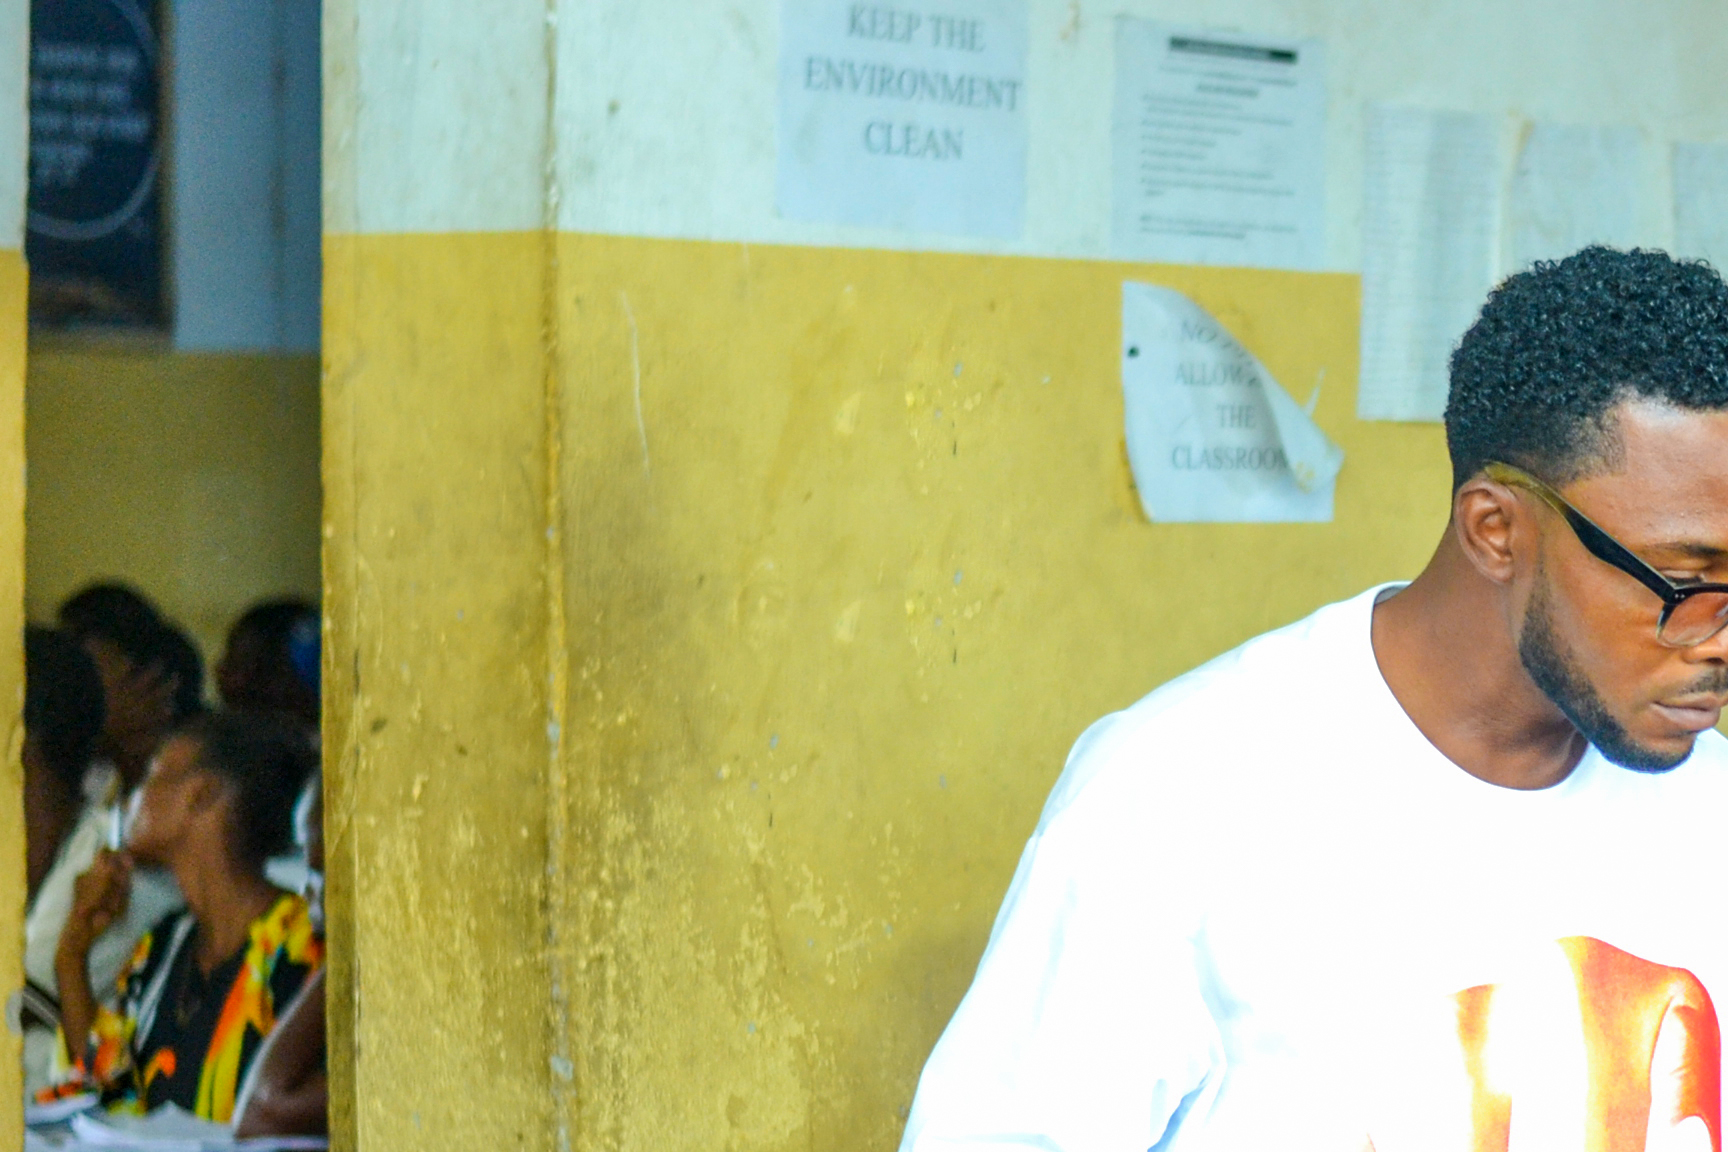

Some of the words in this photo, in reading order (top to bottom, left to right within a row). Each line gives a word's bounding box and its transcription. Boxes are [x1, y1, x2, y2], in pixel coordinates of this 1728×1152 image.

[849, 3, 921, 43] KEEP
[929, 13, 986, 53] THE
[804, 55, 1023, 112] ENVIRONMENT
[864, 120, 964, 160] CLEAN
[1215, 403, 1257, 430] THE
